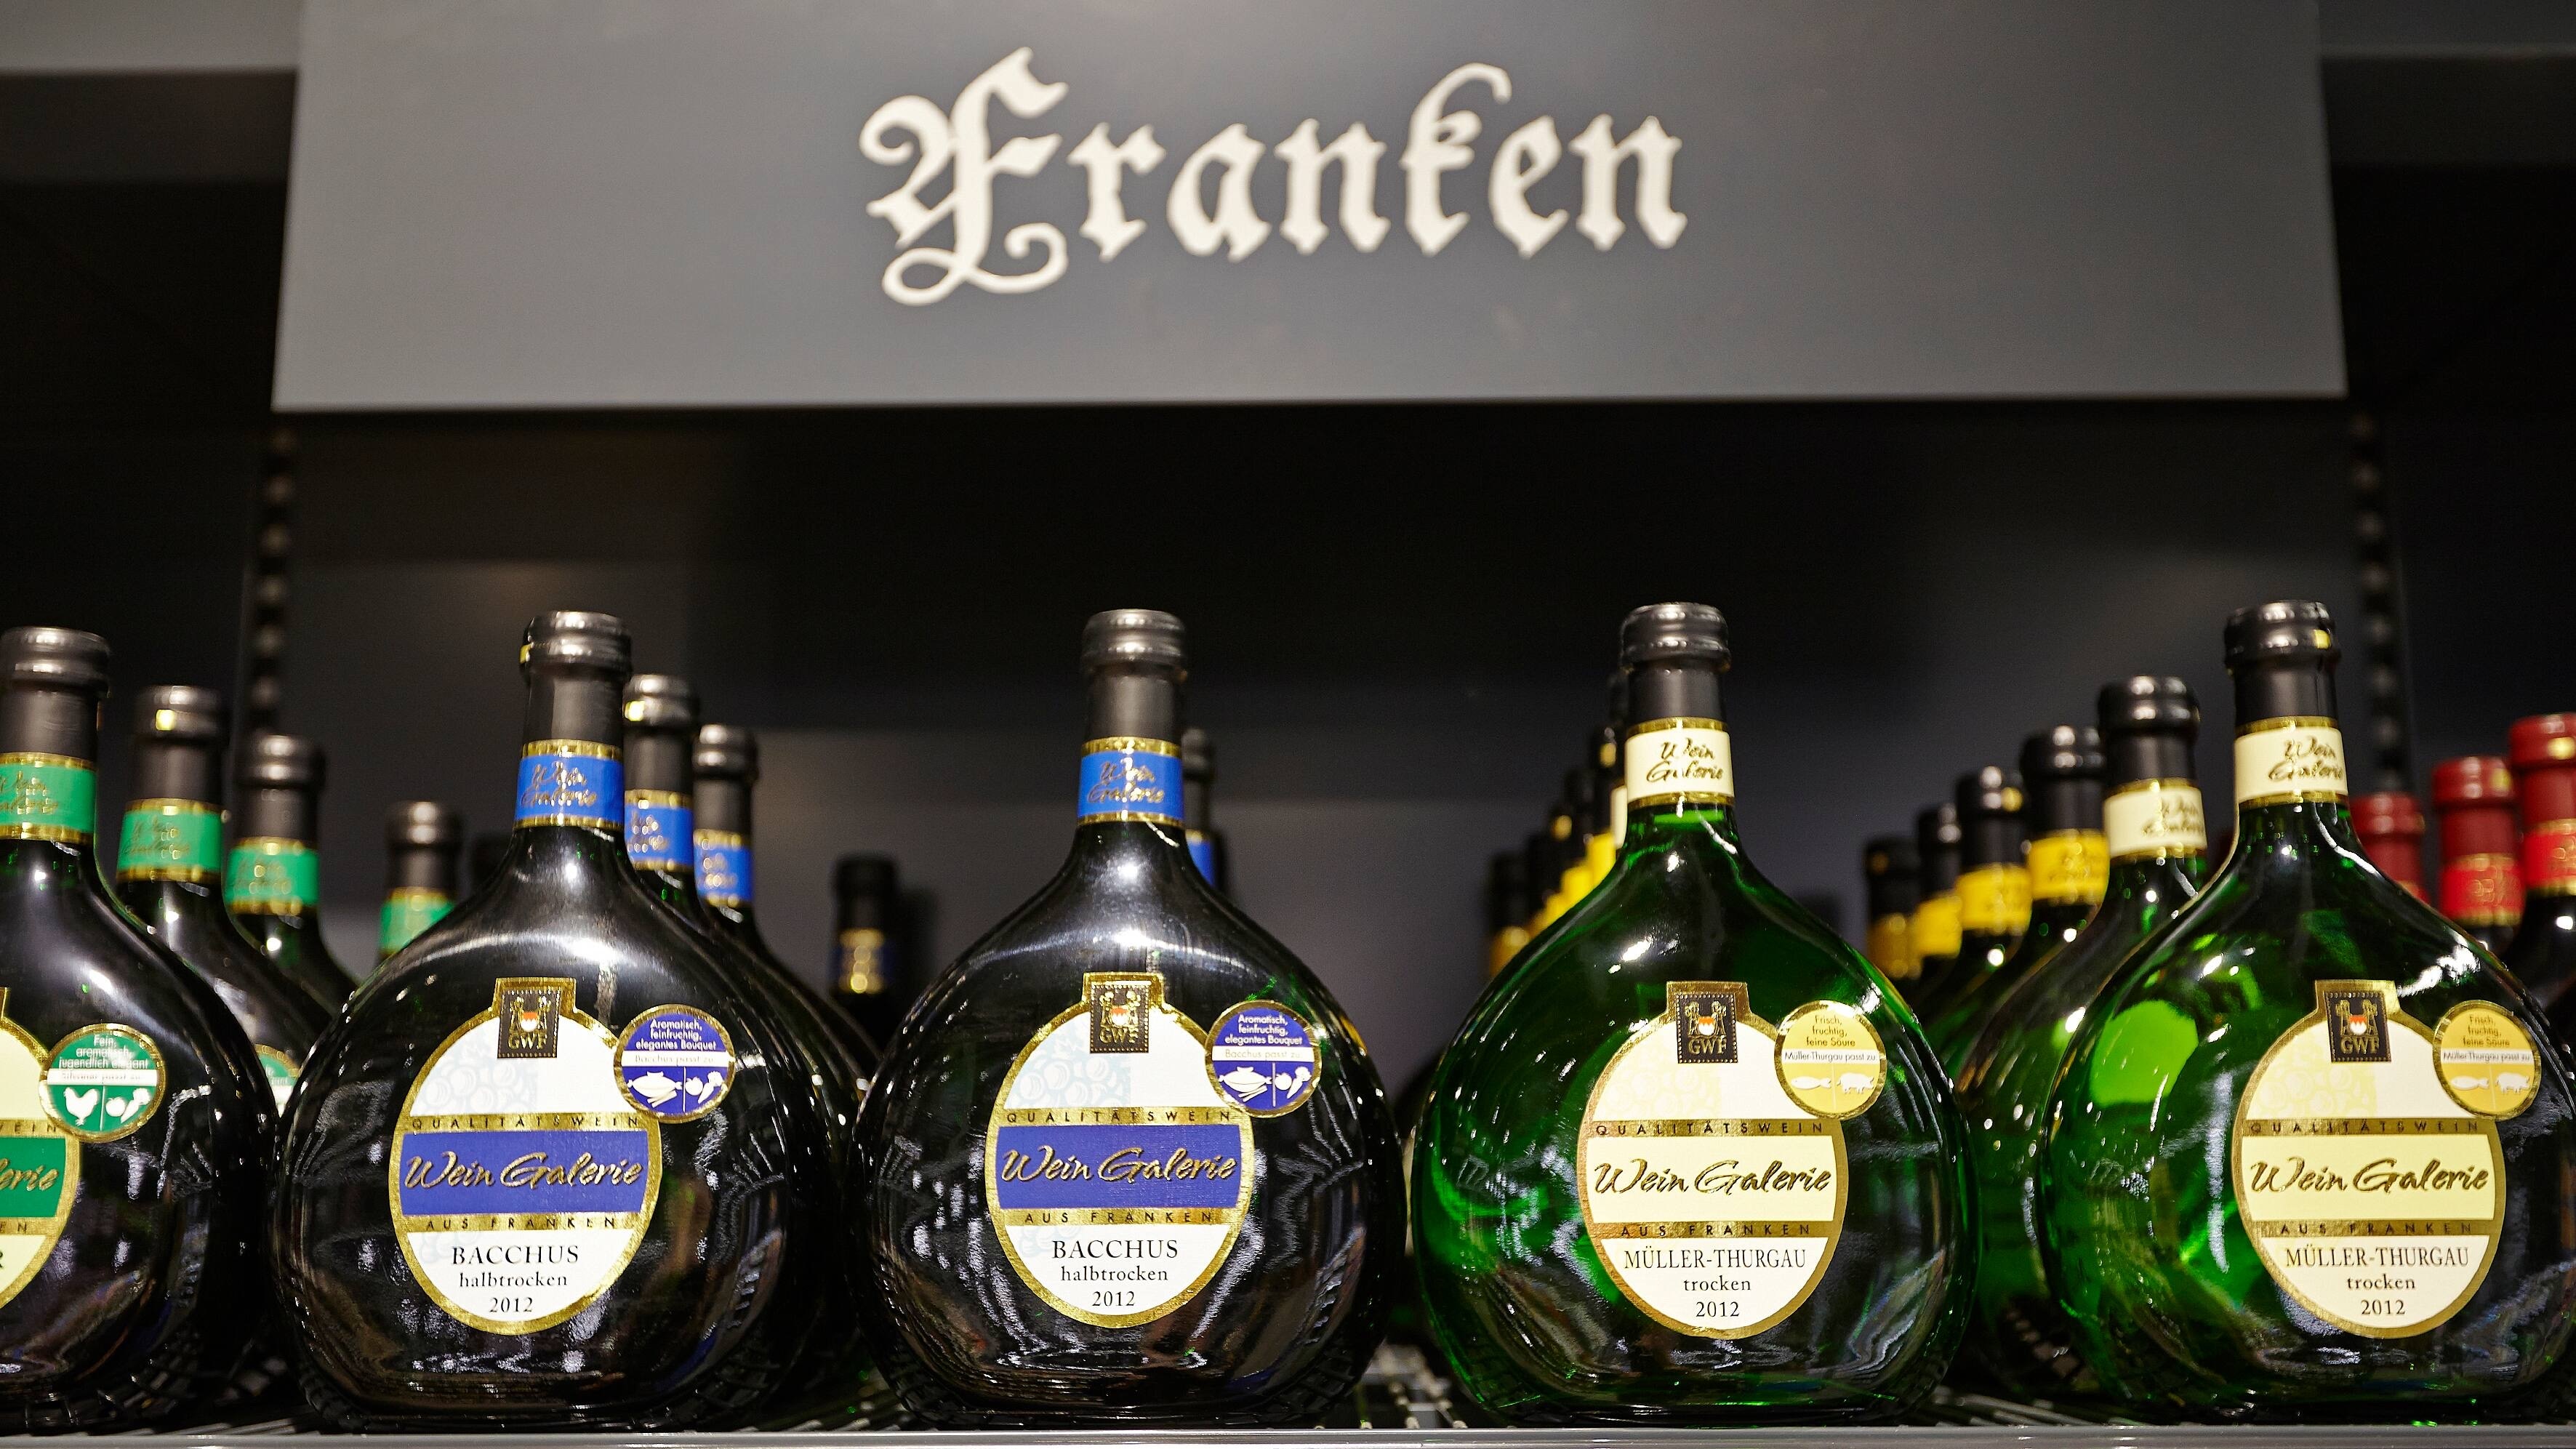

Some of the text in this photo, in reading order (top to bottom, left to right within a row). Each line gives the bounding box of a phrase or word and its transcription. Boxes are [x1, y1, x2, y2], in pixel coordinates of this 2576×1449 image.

[860, 47, 1688, 305] Franken
[650, 1019, 702, 1031] Aromatisch,
[1237, 1014, 1288, 1025] Aromatisch,
[1815, 1015, 1842, 1025] Frisch,
[1237, 1024, 1288, 1036] feinfruchtig,
[1812, 1025, 1847, 1037] fruchtig,
[507, 1033, 547, 1051] GWF
[635, 1038, 716, 1051] elegantes Bouquet
[1224, 1034, 1303, 1046] elegantes Bouquet
[1688, 1037, 1728, 1055] GWF
[1806, 1036, 1828, 1046] feine
[2340, 1036, 2380, 1054] GWF
[1225, 1049, 1262, 1058] Bacchus
[1845, 1052, 1864, 1062] passt
[59, 1056, 108, 1069] jugendlich
[0, 1121, 56, 1133] EIN
[1594, 1119, 1823, 1136] QUALITÄTSWEIN
[404, 1150, 644, 1189] Wein Galerie
[1000, 1145, 1237, 1184] Wein Galerie
[1593, 1158, 1832, 1195] Wein Galerie
[2250, 1156, 2489, 1195] Wein Galerie
[426, 1219, 469, 1230] AUS
[1024, 1211, 1212, 1224] AUS FRANKEN
[1621, 1223, 1810, 1237] AUS FRANKEN
[2281, 1221, 2473, 1235] AUS FRANKEN
[452, 1245, 579, 1265] BACCHUS
[1051, 1239, 1179, 1259] BACCHUS
[1624, 1245, 1807, 1269] MÜLLER-THURGAU
[2285, 1244, 2470, 1267] MÜLLER-THURGAU
[459, 1270, 568, 1288] halbtrocken
[1061, 1266, 1169, 1282] halbtrocken
[1683, 1277, 1752, 1291] trocken
[2346, 1275, 2416, 1291] trocken
[488, 1297, 534, 1313] 2012
[1091, 1291, 1136, 1307] 2012
[1695, 1301, 1740, 1318] 2012
[2361, 1299, 2407, 1316] 2012
